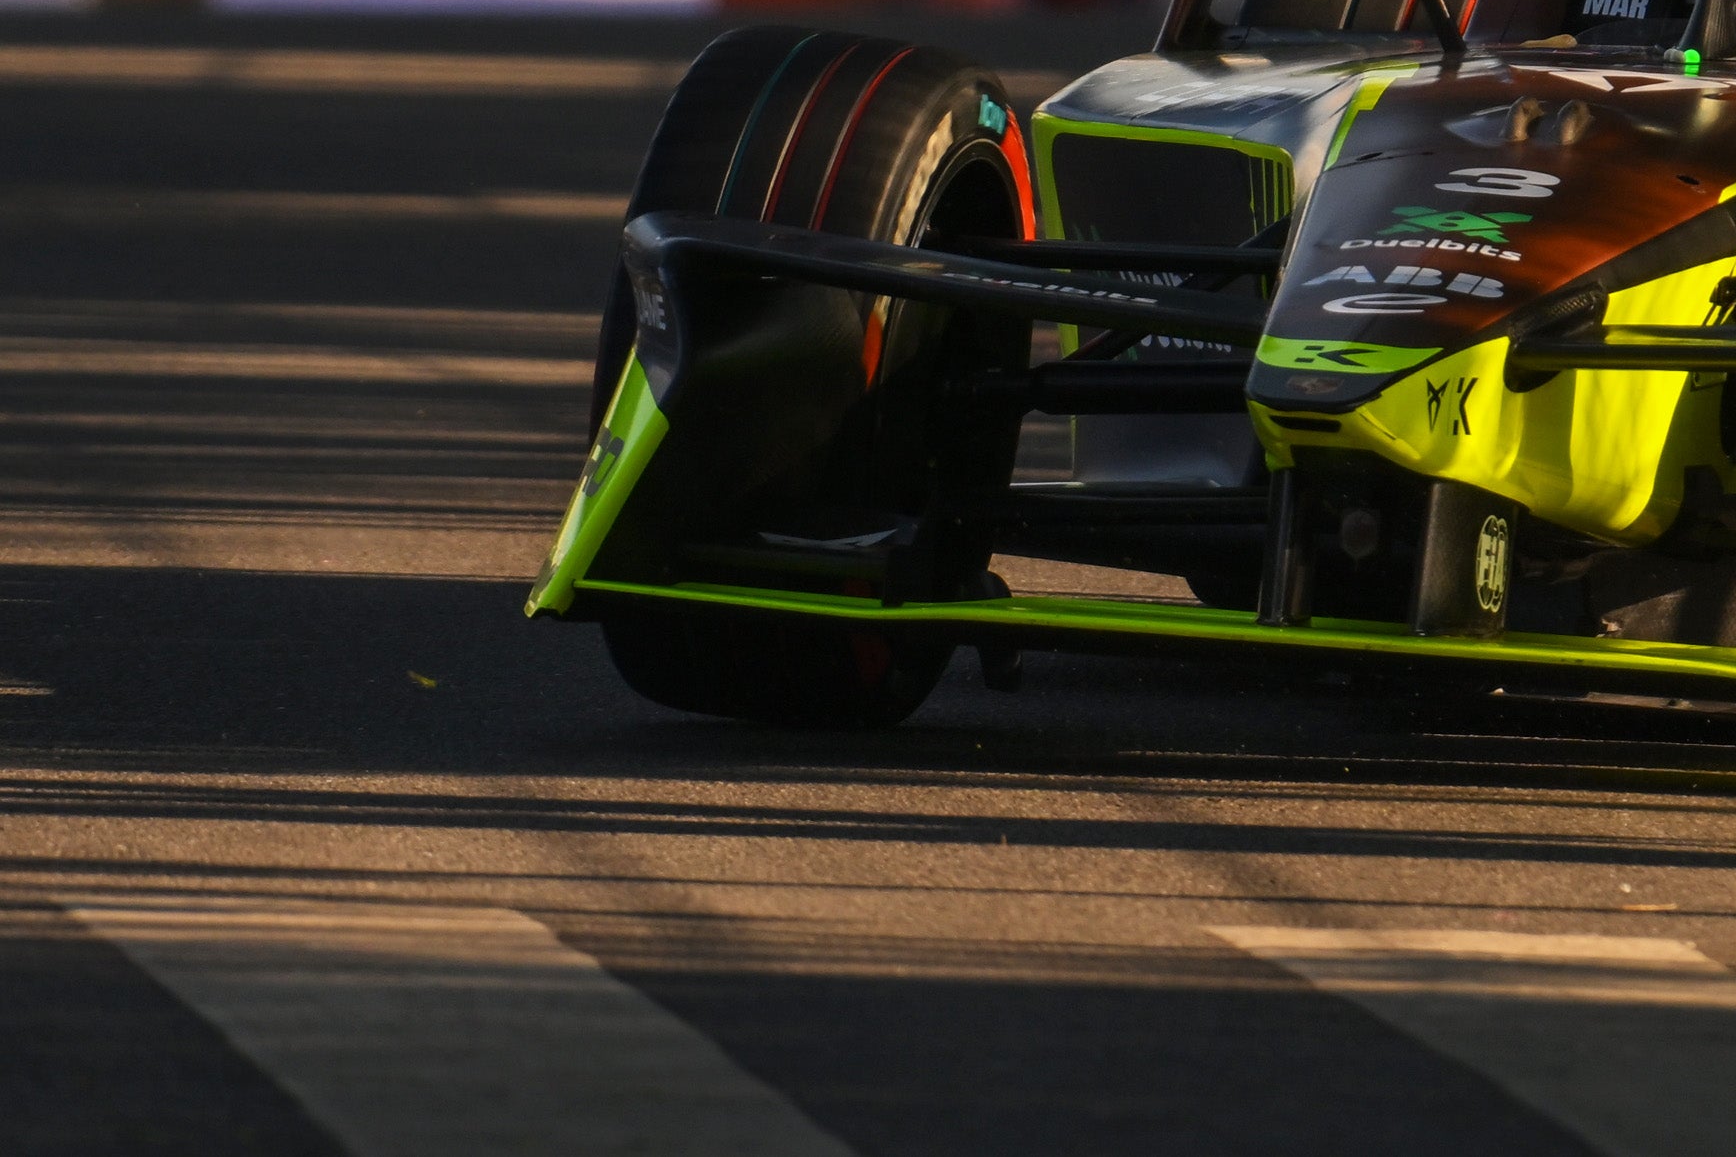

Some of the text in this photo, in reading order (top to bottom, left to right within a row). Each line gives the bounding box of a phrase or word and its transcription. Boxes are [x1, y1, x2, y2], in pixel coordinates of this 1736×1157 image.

[1434, 167, 1562, 198] 3
[1339, 238, 1522, 262] Duelbits
[1302, 265, 1504, 298] ABB
